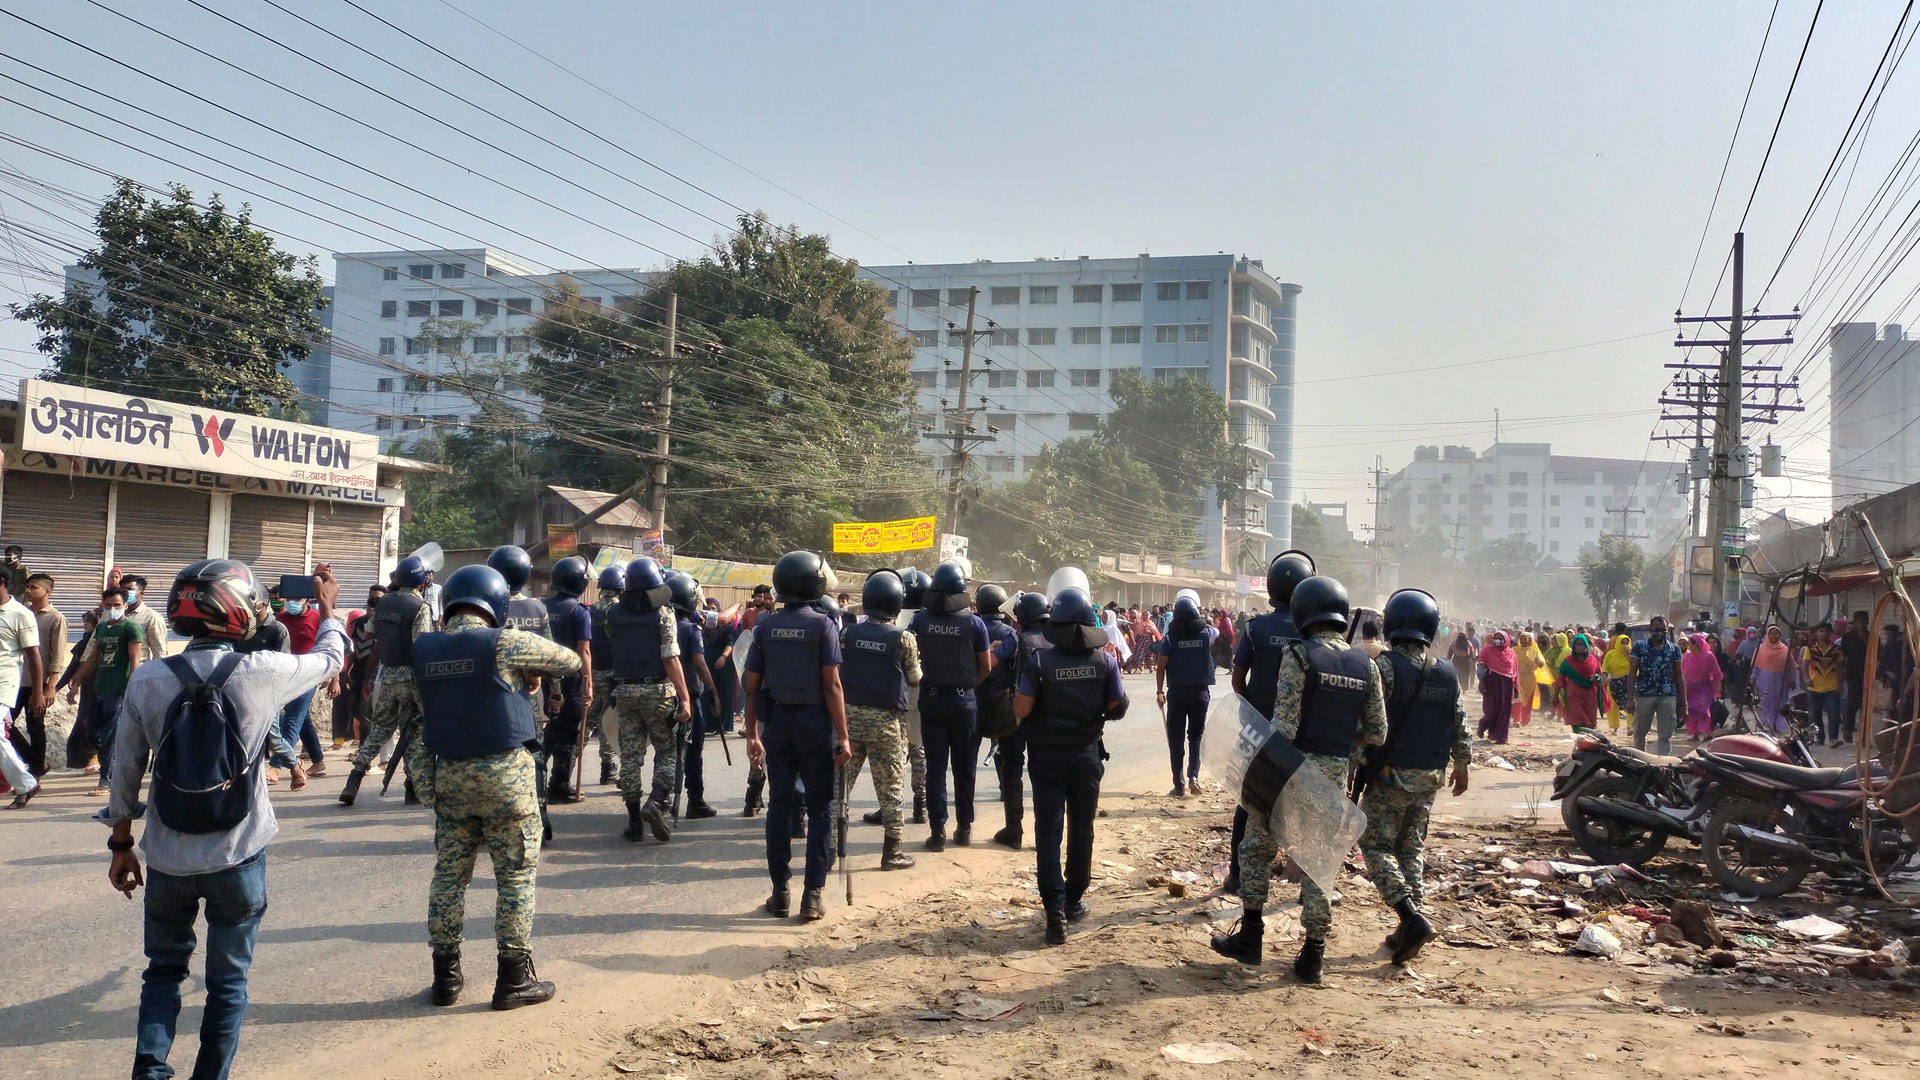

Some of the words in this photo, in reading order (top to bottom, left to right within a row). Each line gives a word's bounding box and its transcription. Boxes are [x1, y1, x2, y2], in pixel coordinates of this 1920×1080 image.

[31, 397, 173, 449] ওয়ালটন
[251, 425, 351, 470] WALTON
[86, 456, 231, 488] MARCEL
[506, 617, 540, 627] OLICE
[777, 629, 798, 637] POLICE
[928, 624, 960, 636] POLICE
[860, 641, 880, 650] POLICE
[430, 661, 468, 674] POLICE
[1059, 668, 1091, 678] POLICE
[1320, 672, 1364, 691] POLICE
